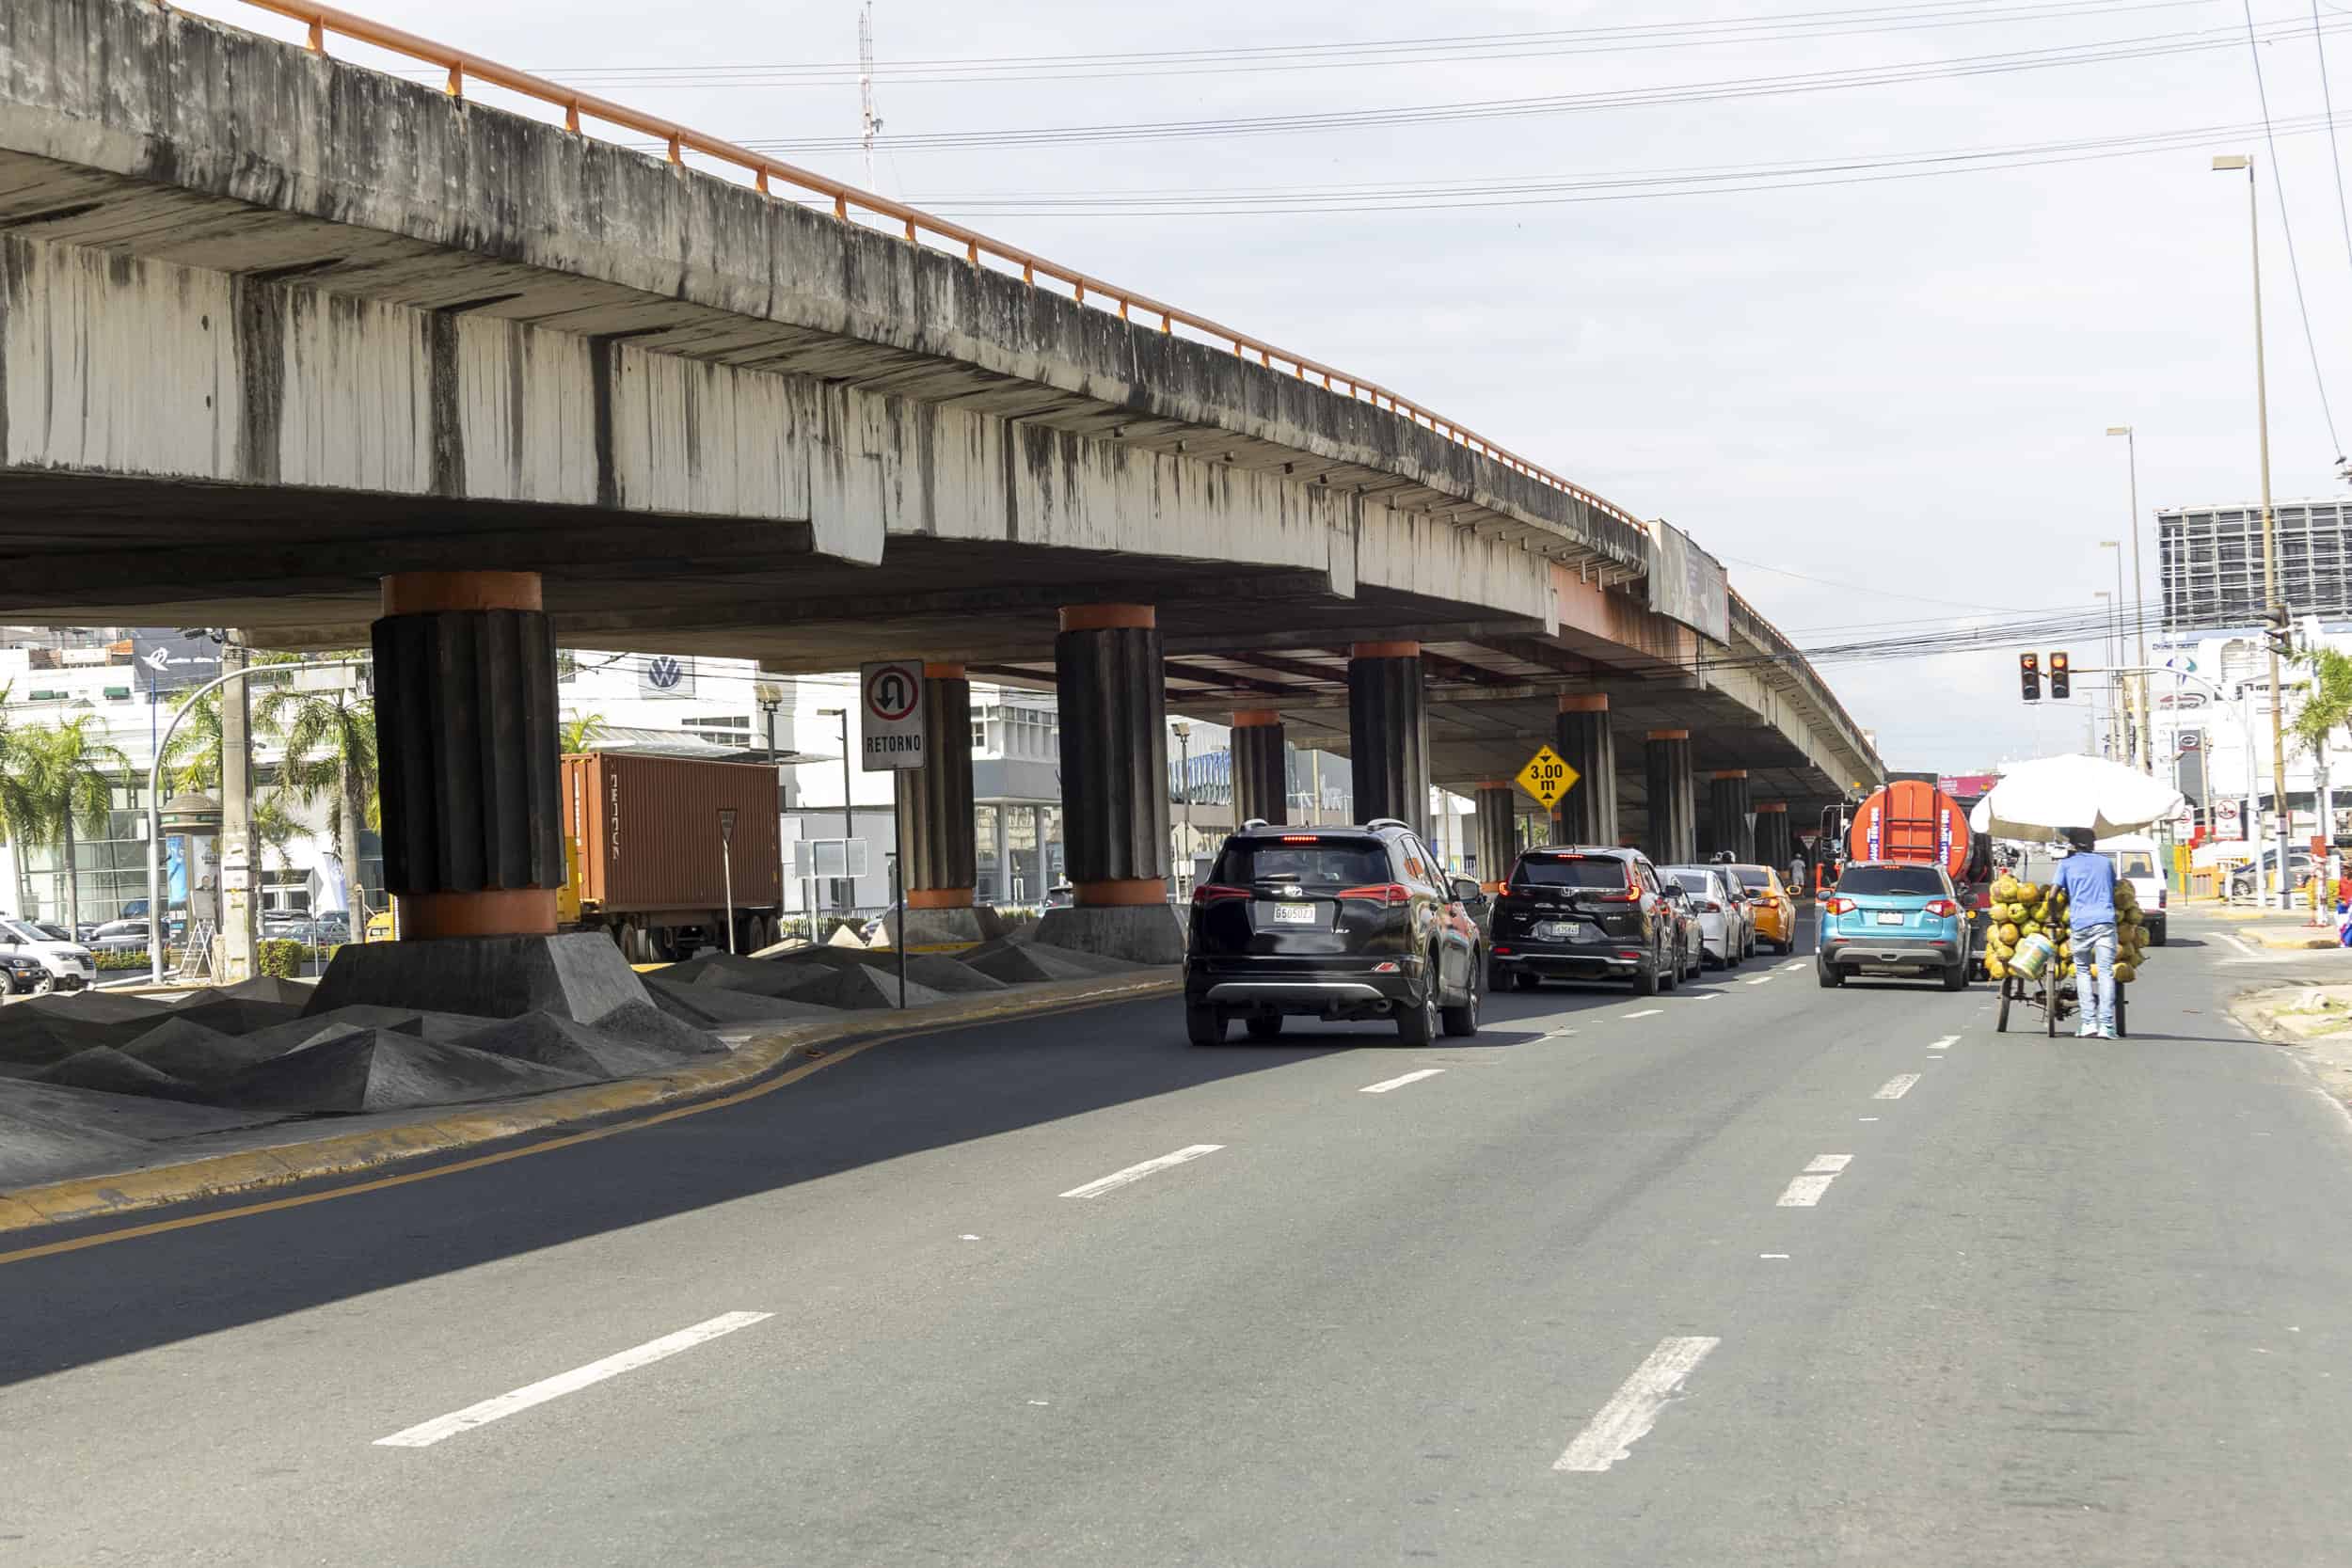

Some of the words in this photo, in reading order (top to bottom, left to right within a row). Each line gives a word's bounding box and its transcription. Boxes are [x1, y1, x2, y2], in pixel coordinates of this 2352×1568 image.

[866, 735, 921, 753] RETORNO
[1531, 764, 1563, 780] 3.00
[1540, 780, 1555, 791] m
